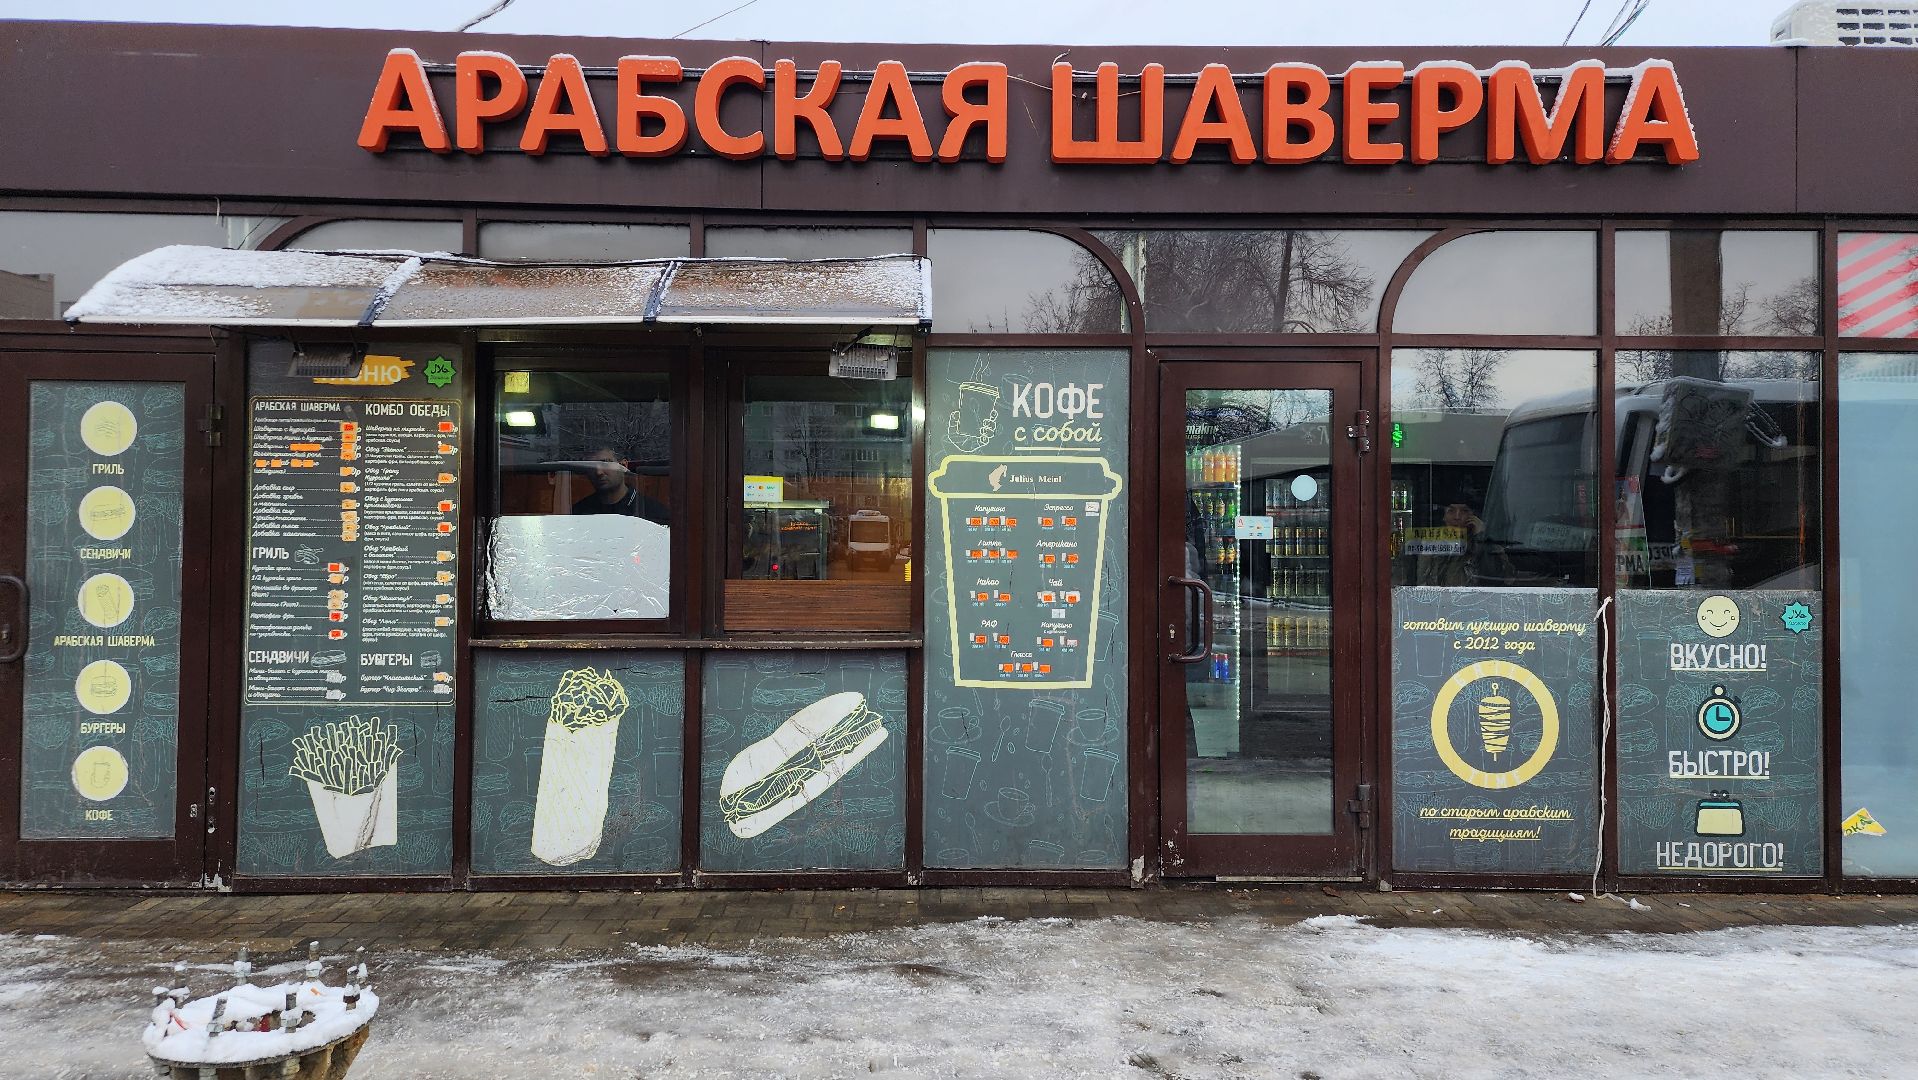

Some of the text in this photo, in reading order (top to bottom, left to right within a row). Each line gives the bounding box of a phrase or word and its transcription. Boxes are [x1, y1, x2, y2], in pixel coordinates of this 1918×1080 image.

[358, 48, 1699, 164] АРАБСКАЯ ШАВЕРМА
[255, 402, 341, 411] АРАБСКАЯ ШАВЕРМА
[1012, 383, 1104, 419] КОФЕ
[365, 404, 450, 417] КОМБО ОБЕДЫ
[253, 425, 283, 433] Шаверма
[289, 426, 316, 434] курицей
[1014, 420, 1102, 442] с собой
[92, 464, 125, 475] ГРИЛЬ
[1009, 475, 1062, 483] Julius Meinl
[974, 504, 1006, 514] Капучино
[1044, 503, 1074, 512] Эспрессо
[1036, 540, 1078, 549] Американо
[80, 548, 131, 560] СЕНДВИЧИ
[252, 547, 290, 560] ГРИЛЬ
[977, 578, 1000, 586] Какао
[1049, 578, 1063, 587] Чай
[981, 620, 998, 628] РАФ
[1041, 621, 1073, 630] Капучино
[1403, 618, 1587, 636] готовим лучшую шаверму
[54, 636, 155, 647] АРАБСКАЯ ШАВЕРМА
[1454, 637, 1536, 654] с 2012 года
[248, 651, 310, 664] СЕНДВИЧИ
[360, 654, 413, 666] БУРГЕРЫ
[1671, 643, 1767, 669] ВКУСНО!
[81, 723, 126, 734] БУРГЕРЫ
[1669, 751, 1770, 776] БЫСТРО!
[86, 810, 114, 821] КОФЕ
[1420, 805, 1572, 821] по старым арабским
[1450, 827, 1541, 842] традициям!
[1656, 841, 1784, 868] НЕДОРОГО!
